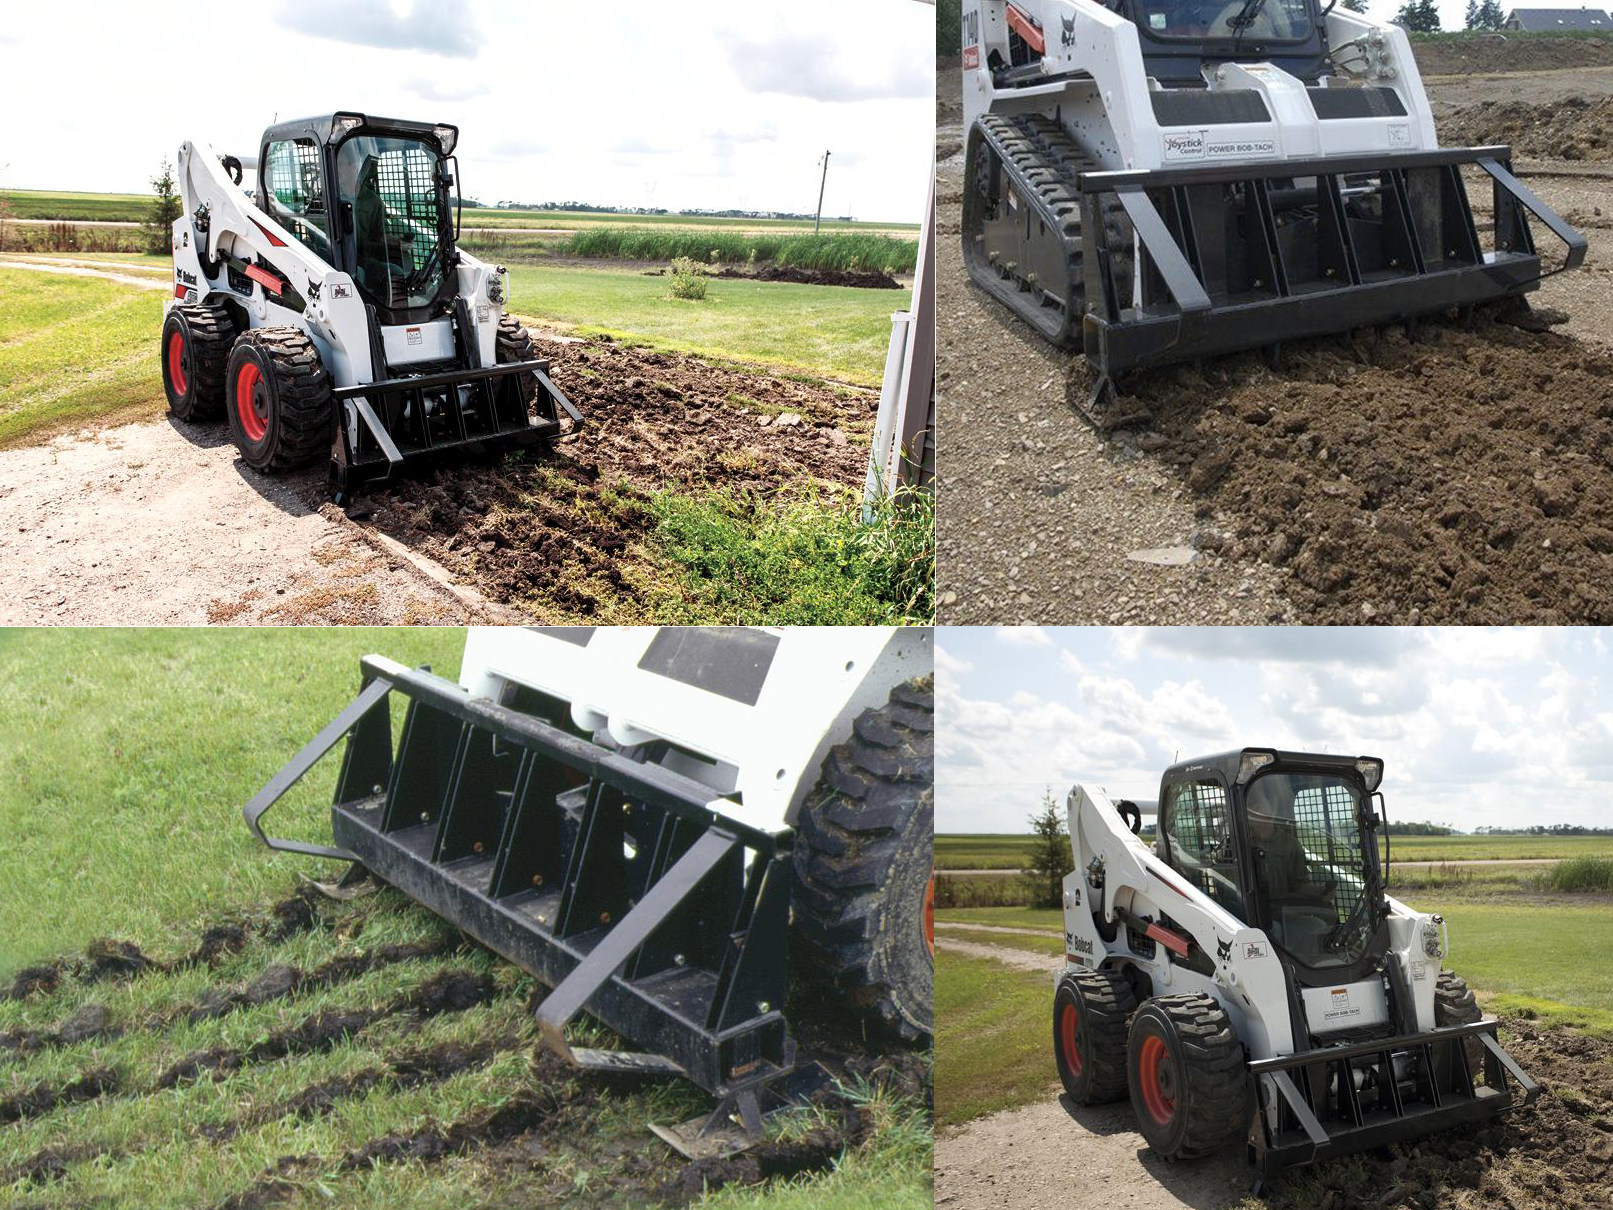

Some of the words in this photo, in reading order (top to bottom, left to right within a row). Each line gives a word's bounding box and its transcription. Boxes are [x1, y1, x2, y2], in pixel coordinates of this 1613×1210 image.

[1165, 138, 1202, 150] Joystick
[1208, 144, 1235, 153] POWER
[1237, 143, 1273, 152] BOB-TACH
[1074, 935, 1093, 955] Bobcat
